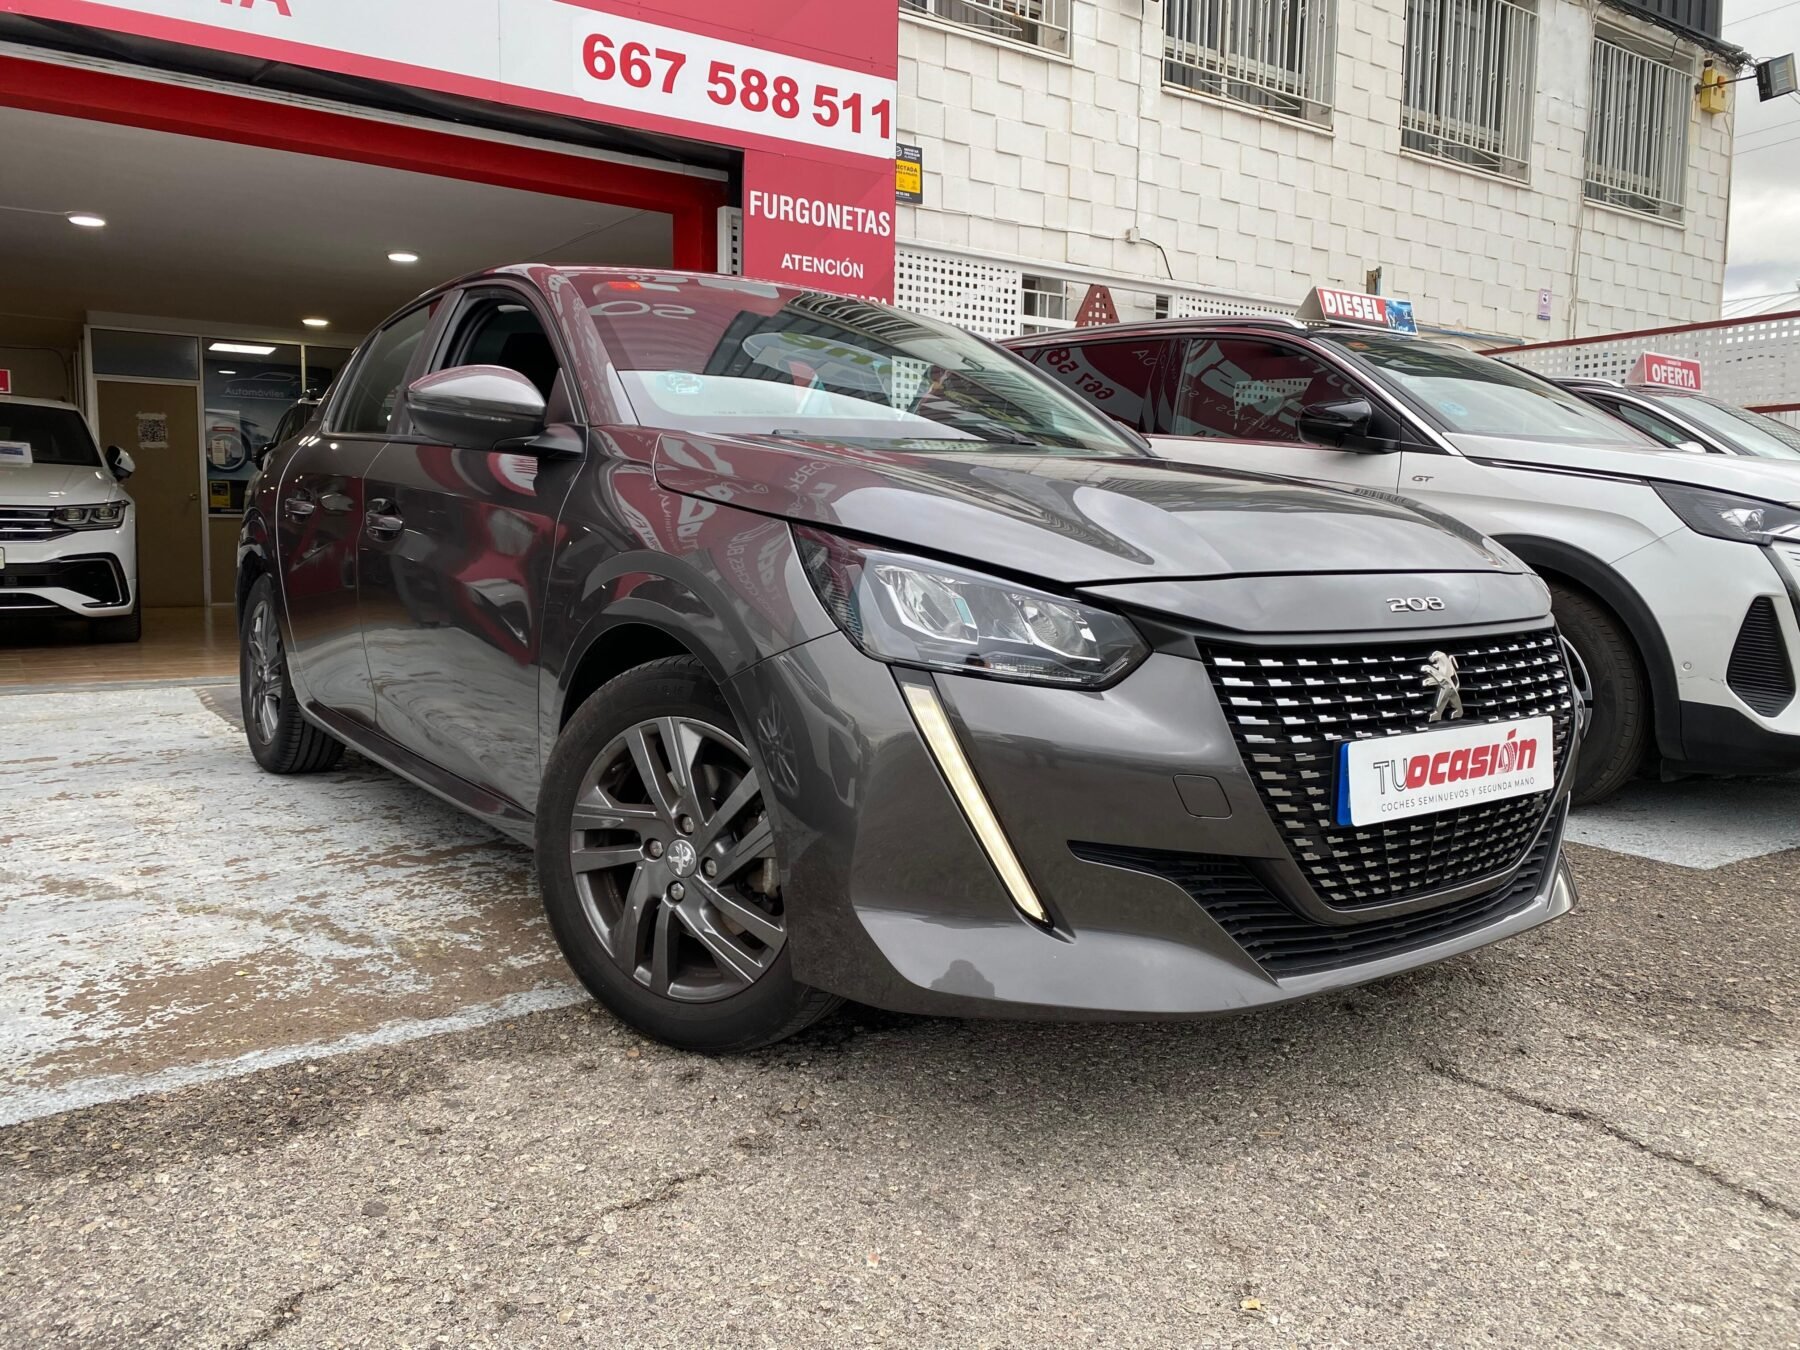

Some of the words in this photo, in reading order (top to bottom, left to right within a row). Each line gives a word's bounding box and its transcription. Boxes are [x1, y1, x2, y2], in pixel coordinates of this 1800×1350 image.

[582, 33, 686, 94] 667
[706, 60, 800, 119] 588
[812, 84, 890, 139] 511
[750, 190, 890, 237] FURGONETAS
[781, 253, 864, 279] ATENCIÓN
[1322, 290, 1384, 321] DIESEL
[1651, 363, 1697, 388] OFERTA
[1386, 597, 1445, 612] 208
[1381, 798, 1416, 813] COCHES
[1418, 789, 1469, 806] SEMINUEVOS
[1471, 788, 1476, 798] Y
[1478, 781, 1513, 796] SEGUNDA
[1514, 776, 1536, 791] MANO
